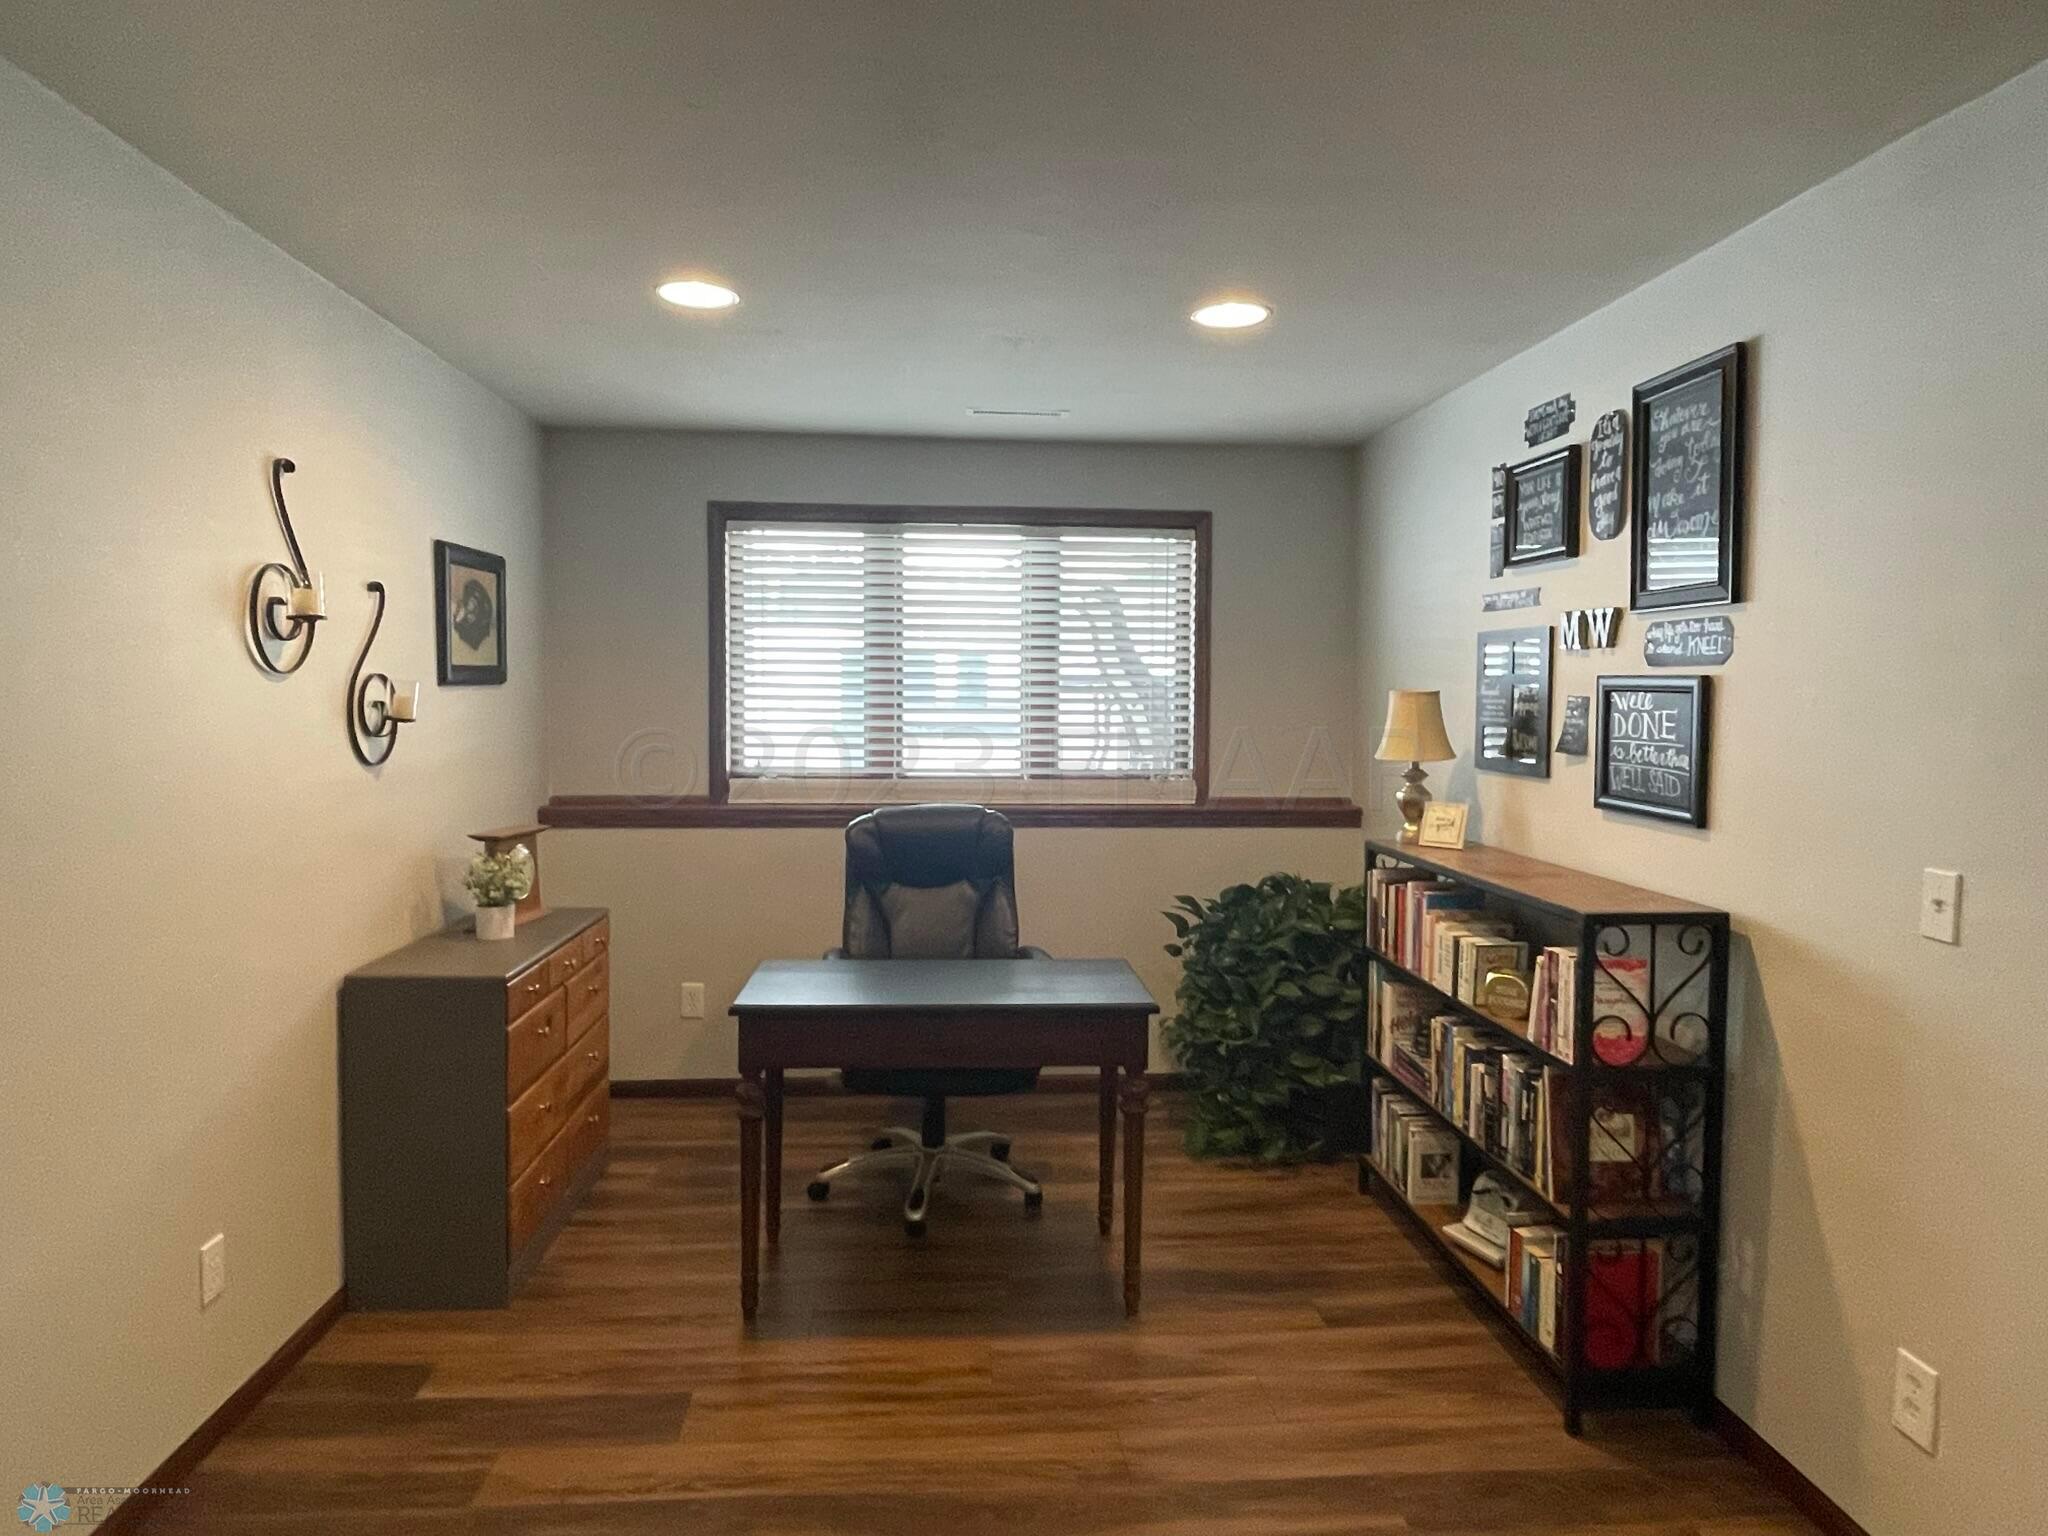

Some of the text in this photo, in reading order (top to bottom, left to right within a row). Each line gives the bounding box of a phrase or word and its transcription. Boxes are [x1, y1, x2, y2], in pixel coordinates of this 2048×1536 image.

[1611, 691, 1654, 711] Well
[1613, 708, 1678, 740] DONE
[1648, 768, 1681, 797] SAID
